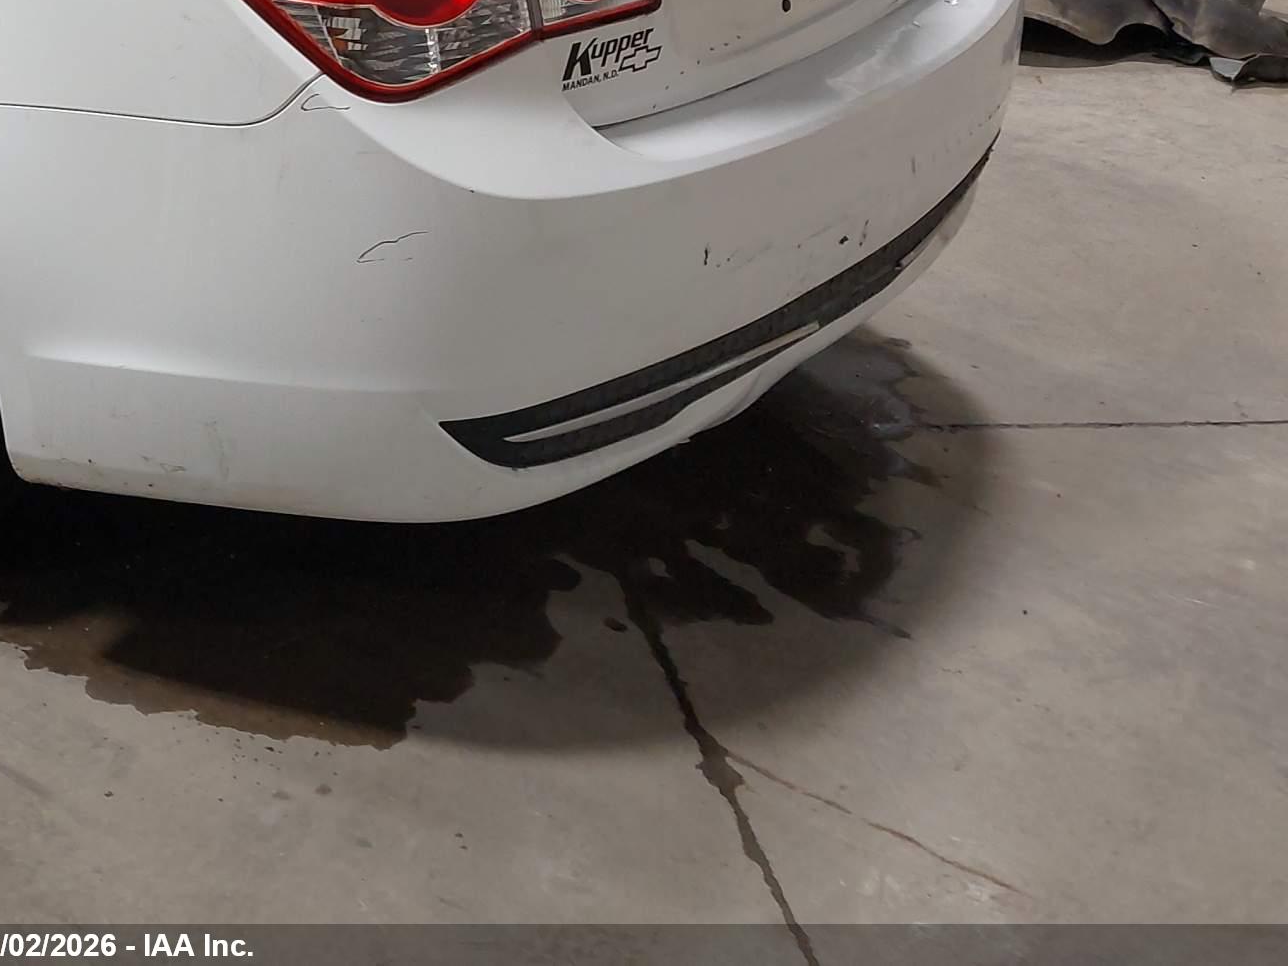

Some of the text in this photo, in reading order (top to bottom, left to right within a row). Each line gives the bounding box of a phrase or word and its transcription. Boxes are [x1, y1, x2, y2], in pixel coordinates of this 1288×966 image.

[562, 27, 654, 81] Kupper
[561, 69, 619, 92] MANDAN, N.D.
